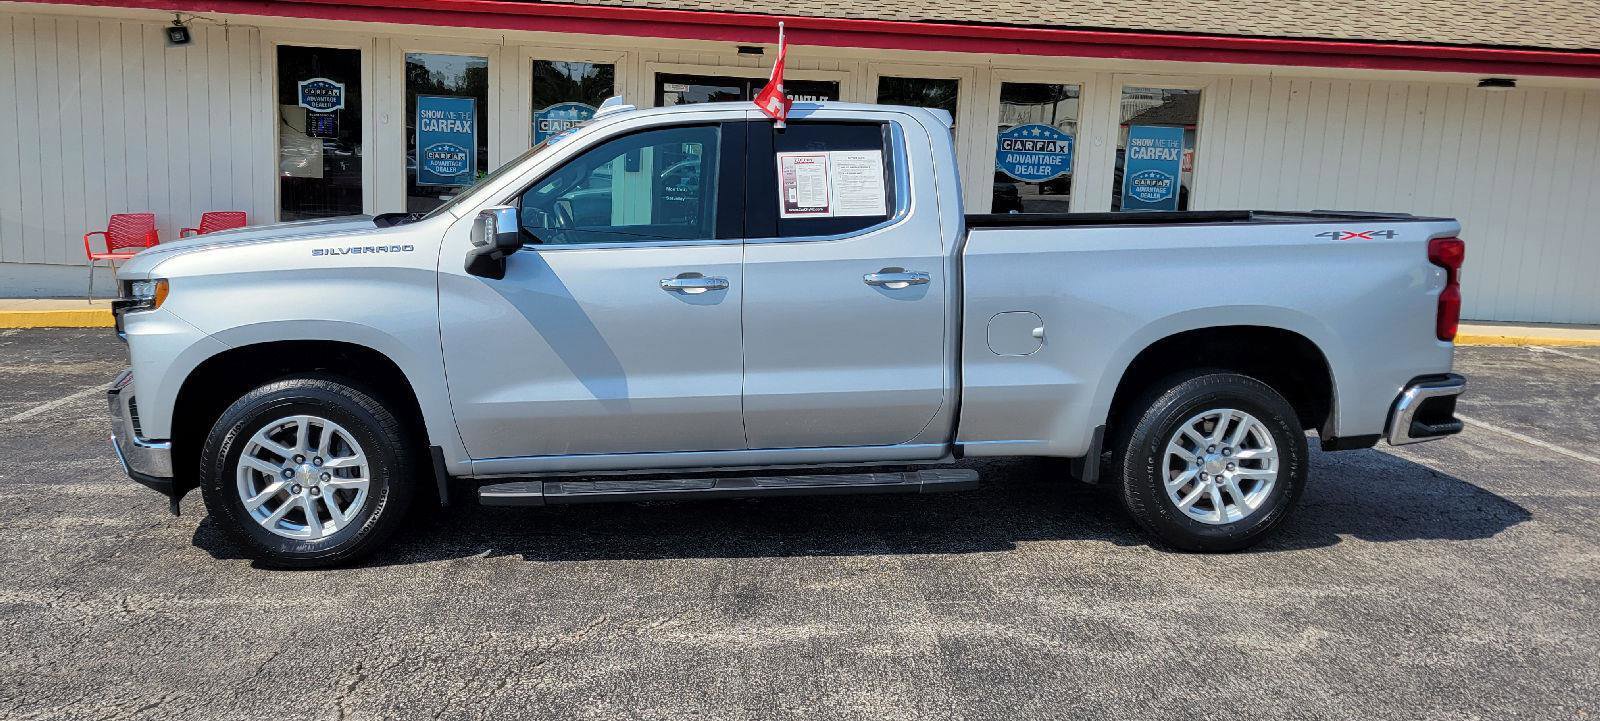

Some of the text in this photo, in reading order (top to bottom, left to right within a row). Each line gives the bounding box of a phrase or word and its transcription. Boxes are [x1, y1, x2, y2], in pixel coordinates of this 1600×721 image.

[304, 88, 340, 97] CARFAX
[421, 110, 472, 120] SHOW ME THE
[421, 119, 472, 133] CARFAX
[1003, 140, 1067, 153] CARFAX
[1131, 138, 1179, 148] SHOW ME THE
[427, 152, 466, 160] CARFAX
[1130, 147, 1178, 161] CARFAX
[1005, 154, 1062, 165] ADVANTAGE
[1014, 165, 1051, 175] DEALER
[1133, 179, 1170, 187] CARFAX
[1136, 187, 1167, 195] ADVANTAGE
[311, 244, 415, 257] SILVERADO
